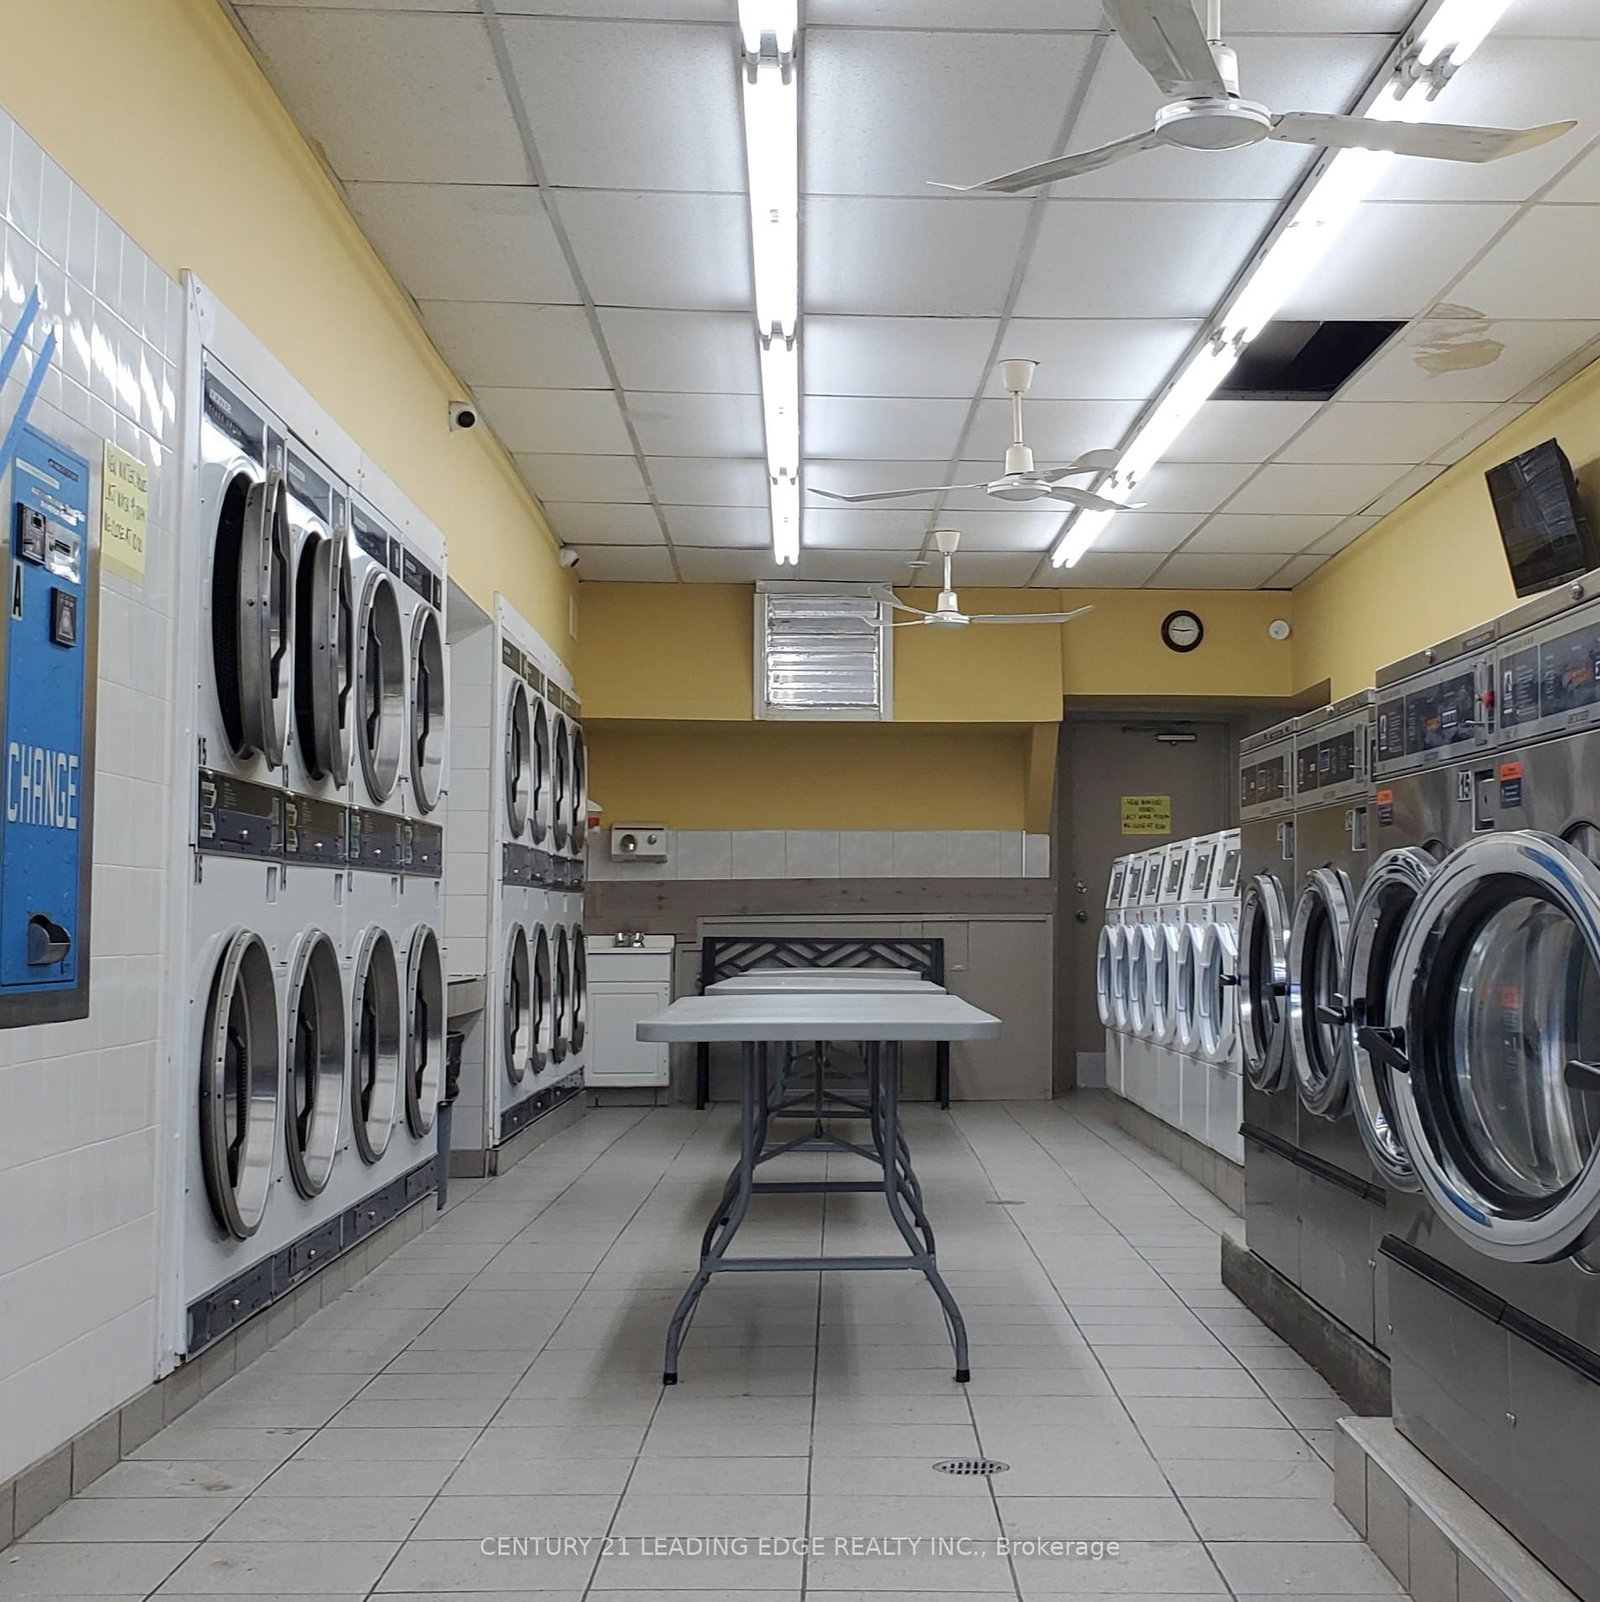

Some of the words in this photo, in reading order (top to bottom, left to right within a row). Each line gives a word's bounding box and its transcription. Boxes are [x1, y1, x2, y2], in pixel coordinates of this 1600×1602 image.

[13, 564, 22, 617] A
[198, 737, 206, 765] 15
[7, 742, 79, 829] CHANGE
[1460, 773, 1470, 799] 15
